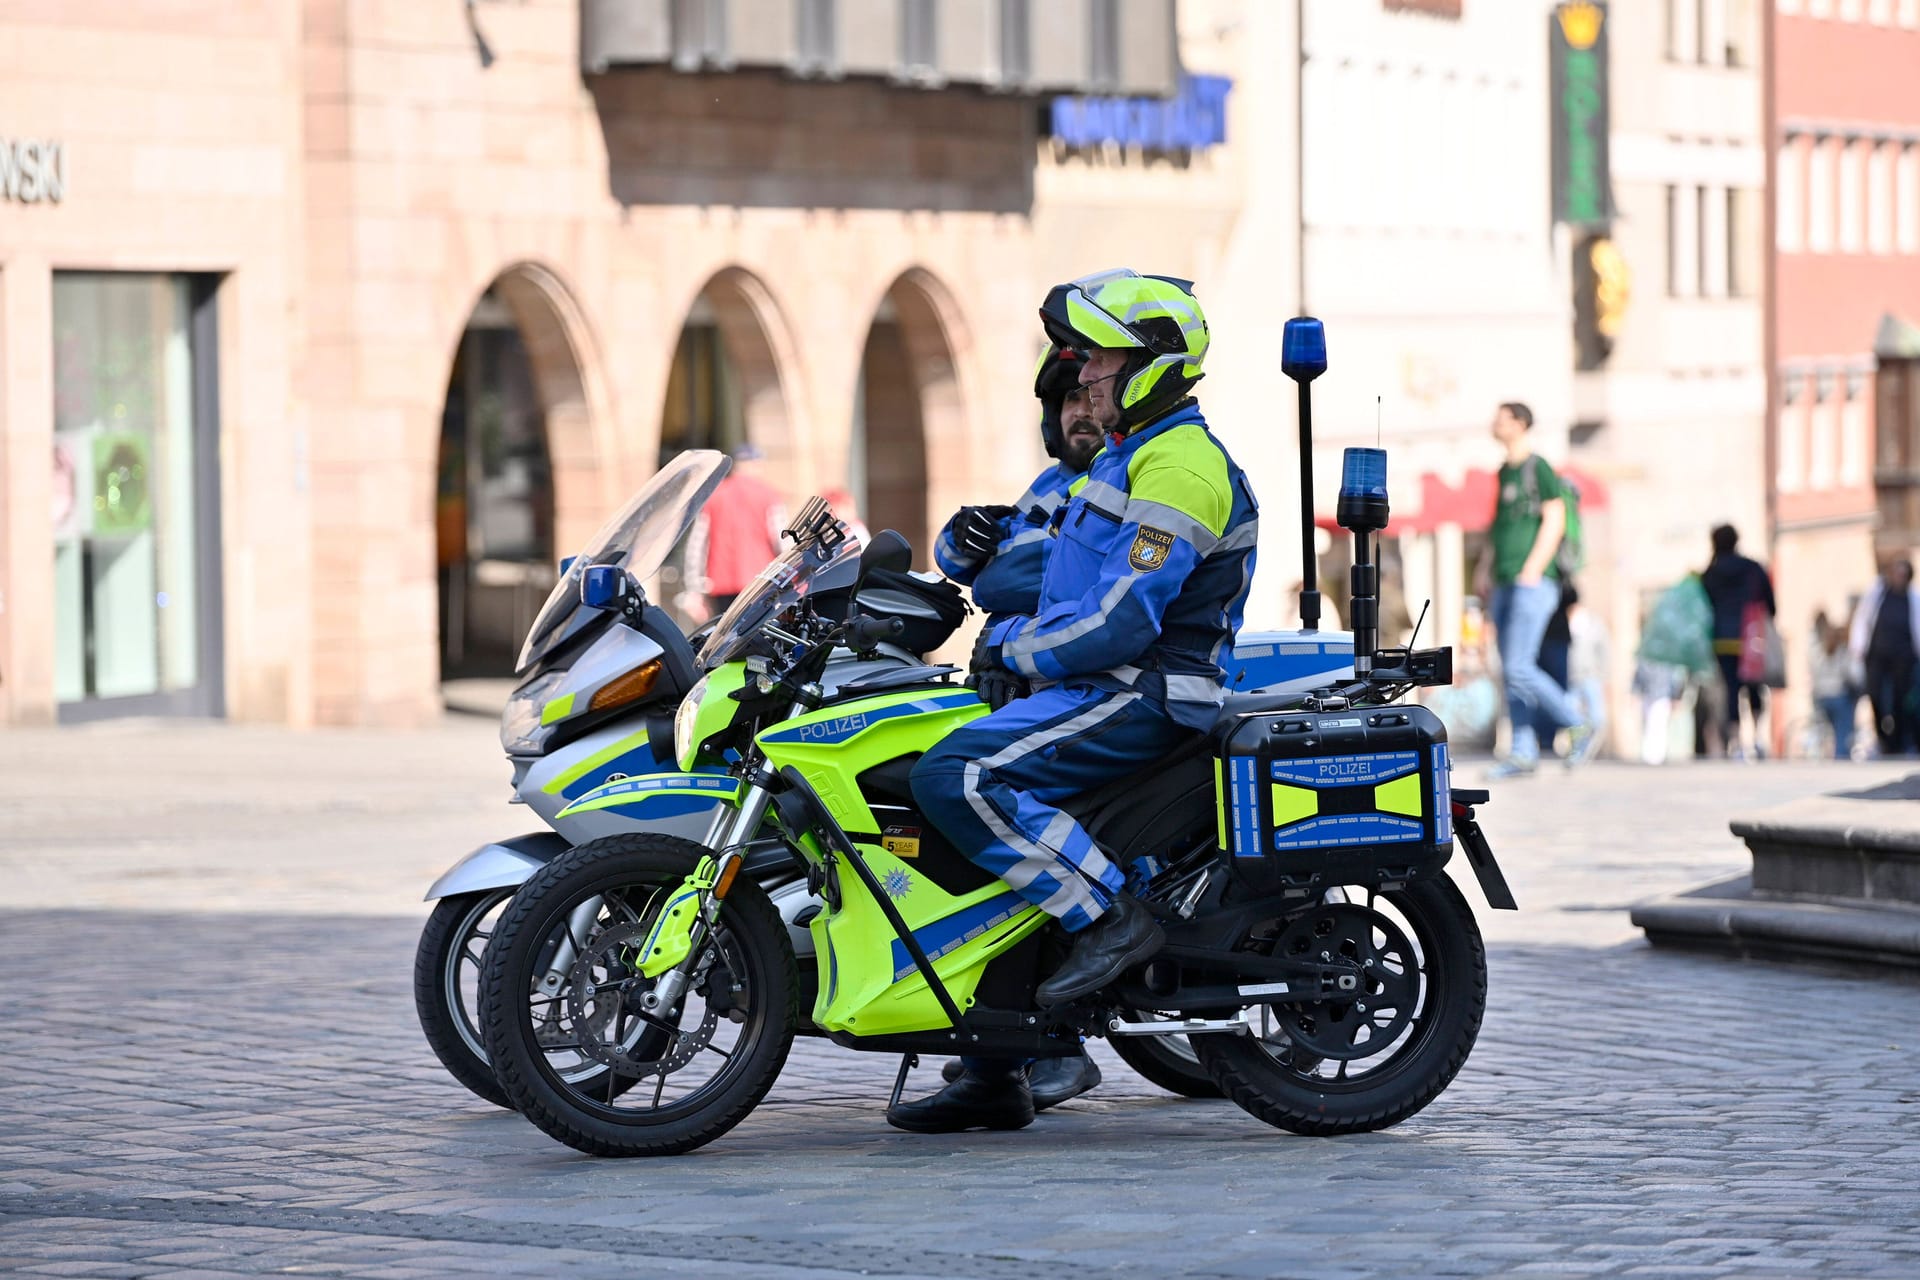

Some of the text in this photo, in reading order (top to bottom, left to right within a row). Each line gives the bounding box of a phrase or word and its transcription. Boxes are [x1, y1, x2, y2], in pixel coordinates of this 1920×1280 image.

[1130, 380, 1142, 401] BMW
[1140, 529, 1171, 544] POLIZEI
[800, 714, 867, 741] POLIZEI
[1320, 762, 1371, 776] POLIZEI
[888, 842, 895, 851] 5
